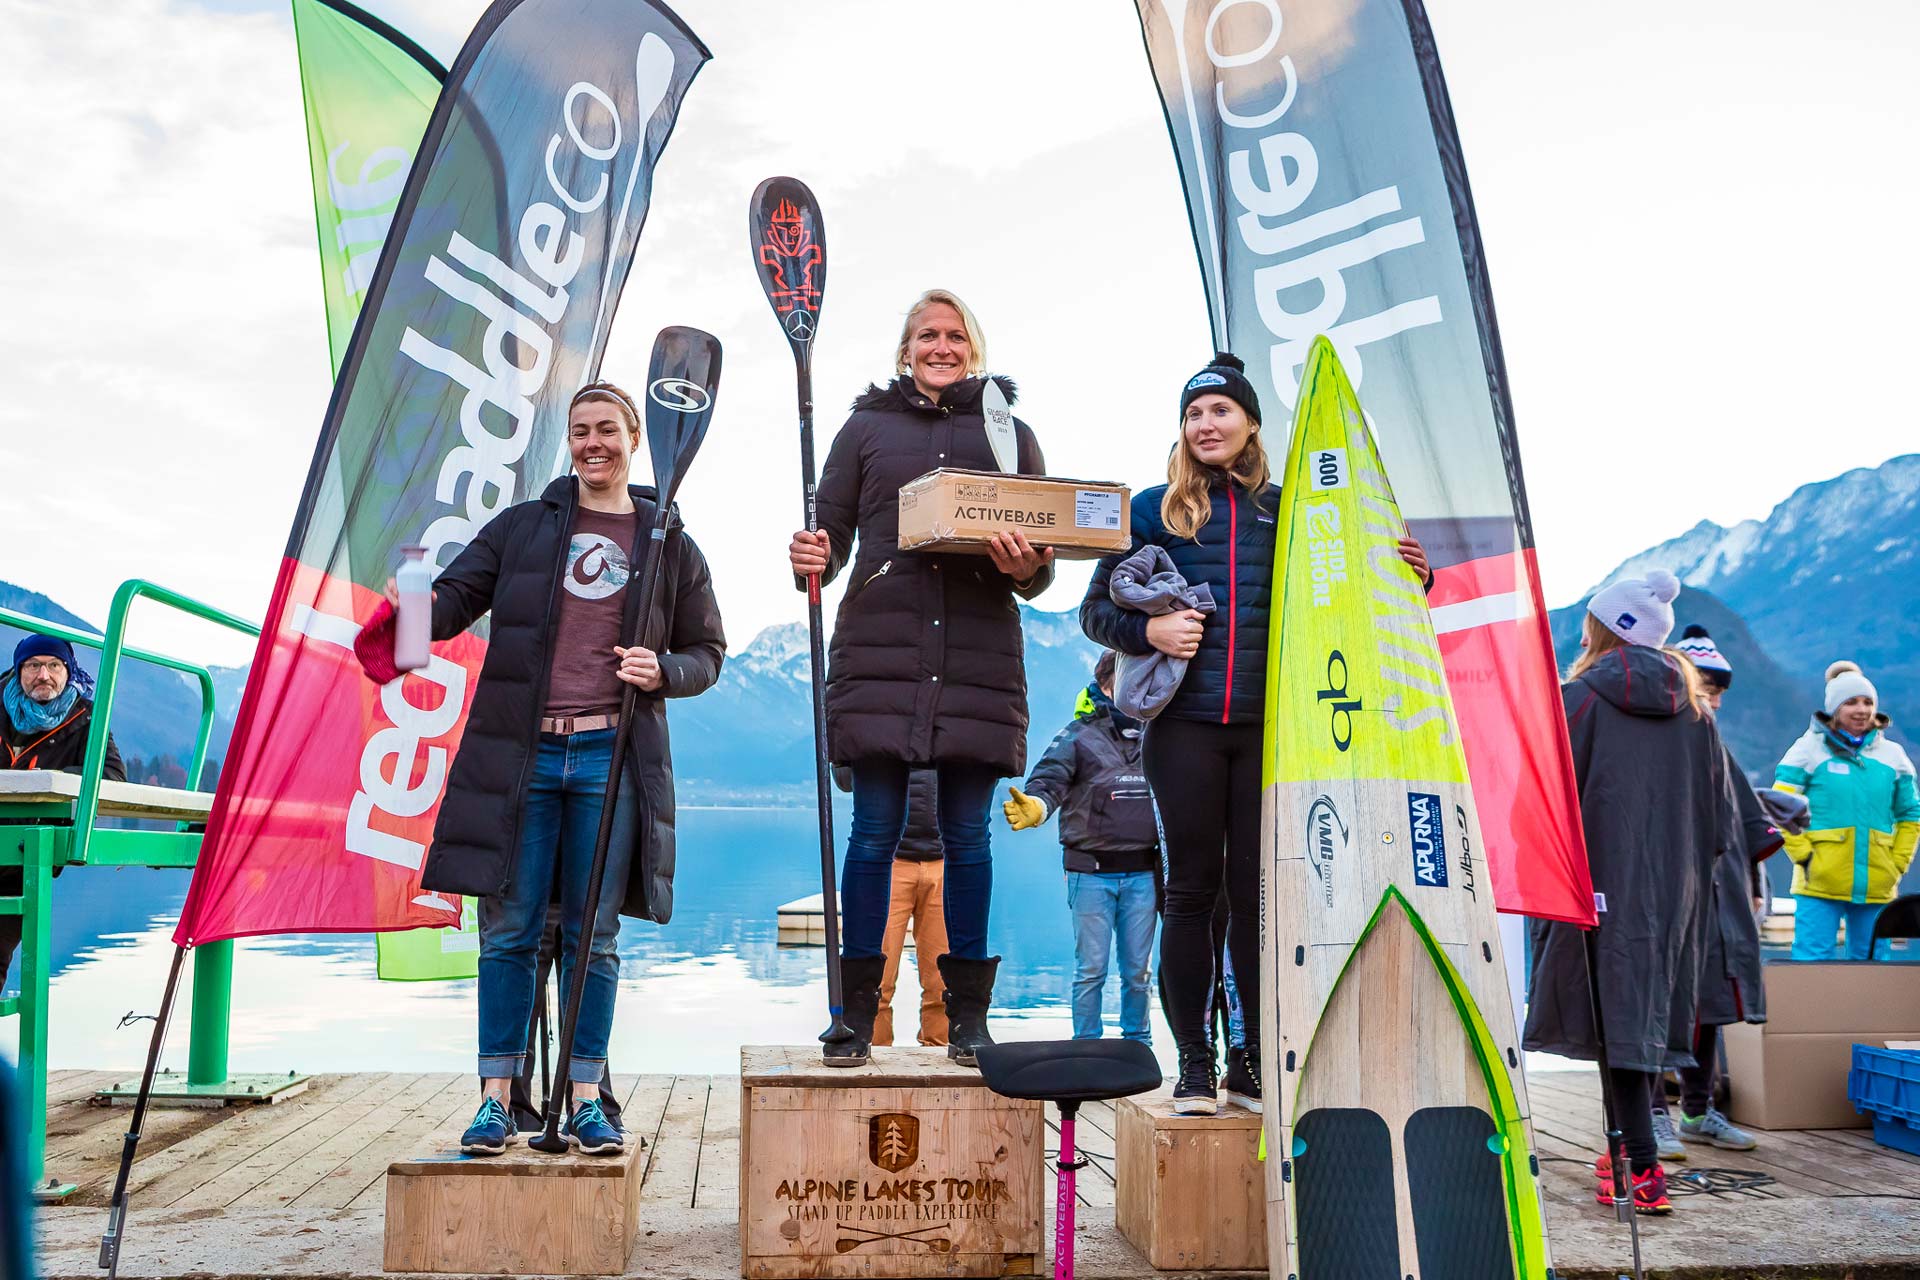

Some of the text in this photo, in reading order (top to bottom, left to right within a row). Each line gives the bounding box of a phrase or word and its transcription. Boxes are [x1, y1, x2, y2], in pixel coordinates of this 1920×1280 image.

[1318, 452, 1339, 487] 400
[807, 483, 817, 533] STARB
[954, 506, 1056, 526] ACTIVEBASE
[1309, 541, 1331, 608] SHORE
[1327, 539, 1347, 583] SIDE
[1412, 797, 1436, 884] APURNA
[1458, 836, 1476, 904] Julbo
[775, 1178, 1012, 1203] ALPINE LAKES TOUR
[787, 1203, 998, 1221] STAND UP PADDLE EXPERIENCE
[1057, 1173, 1067, 1267] ACTIVEBASE
